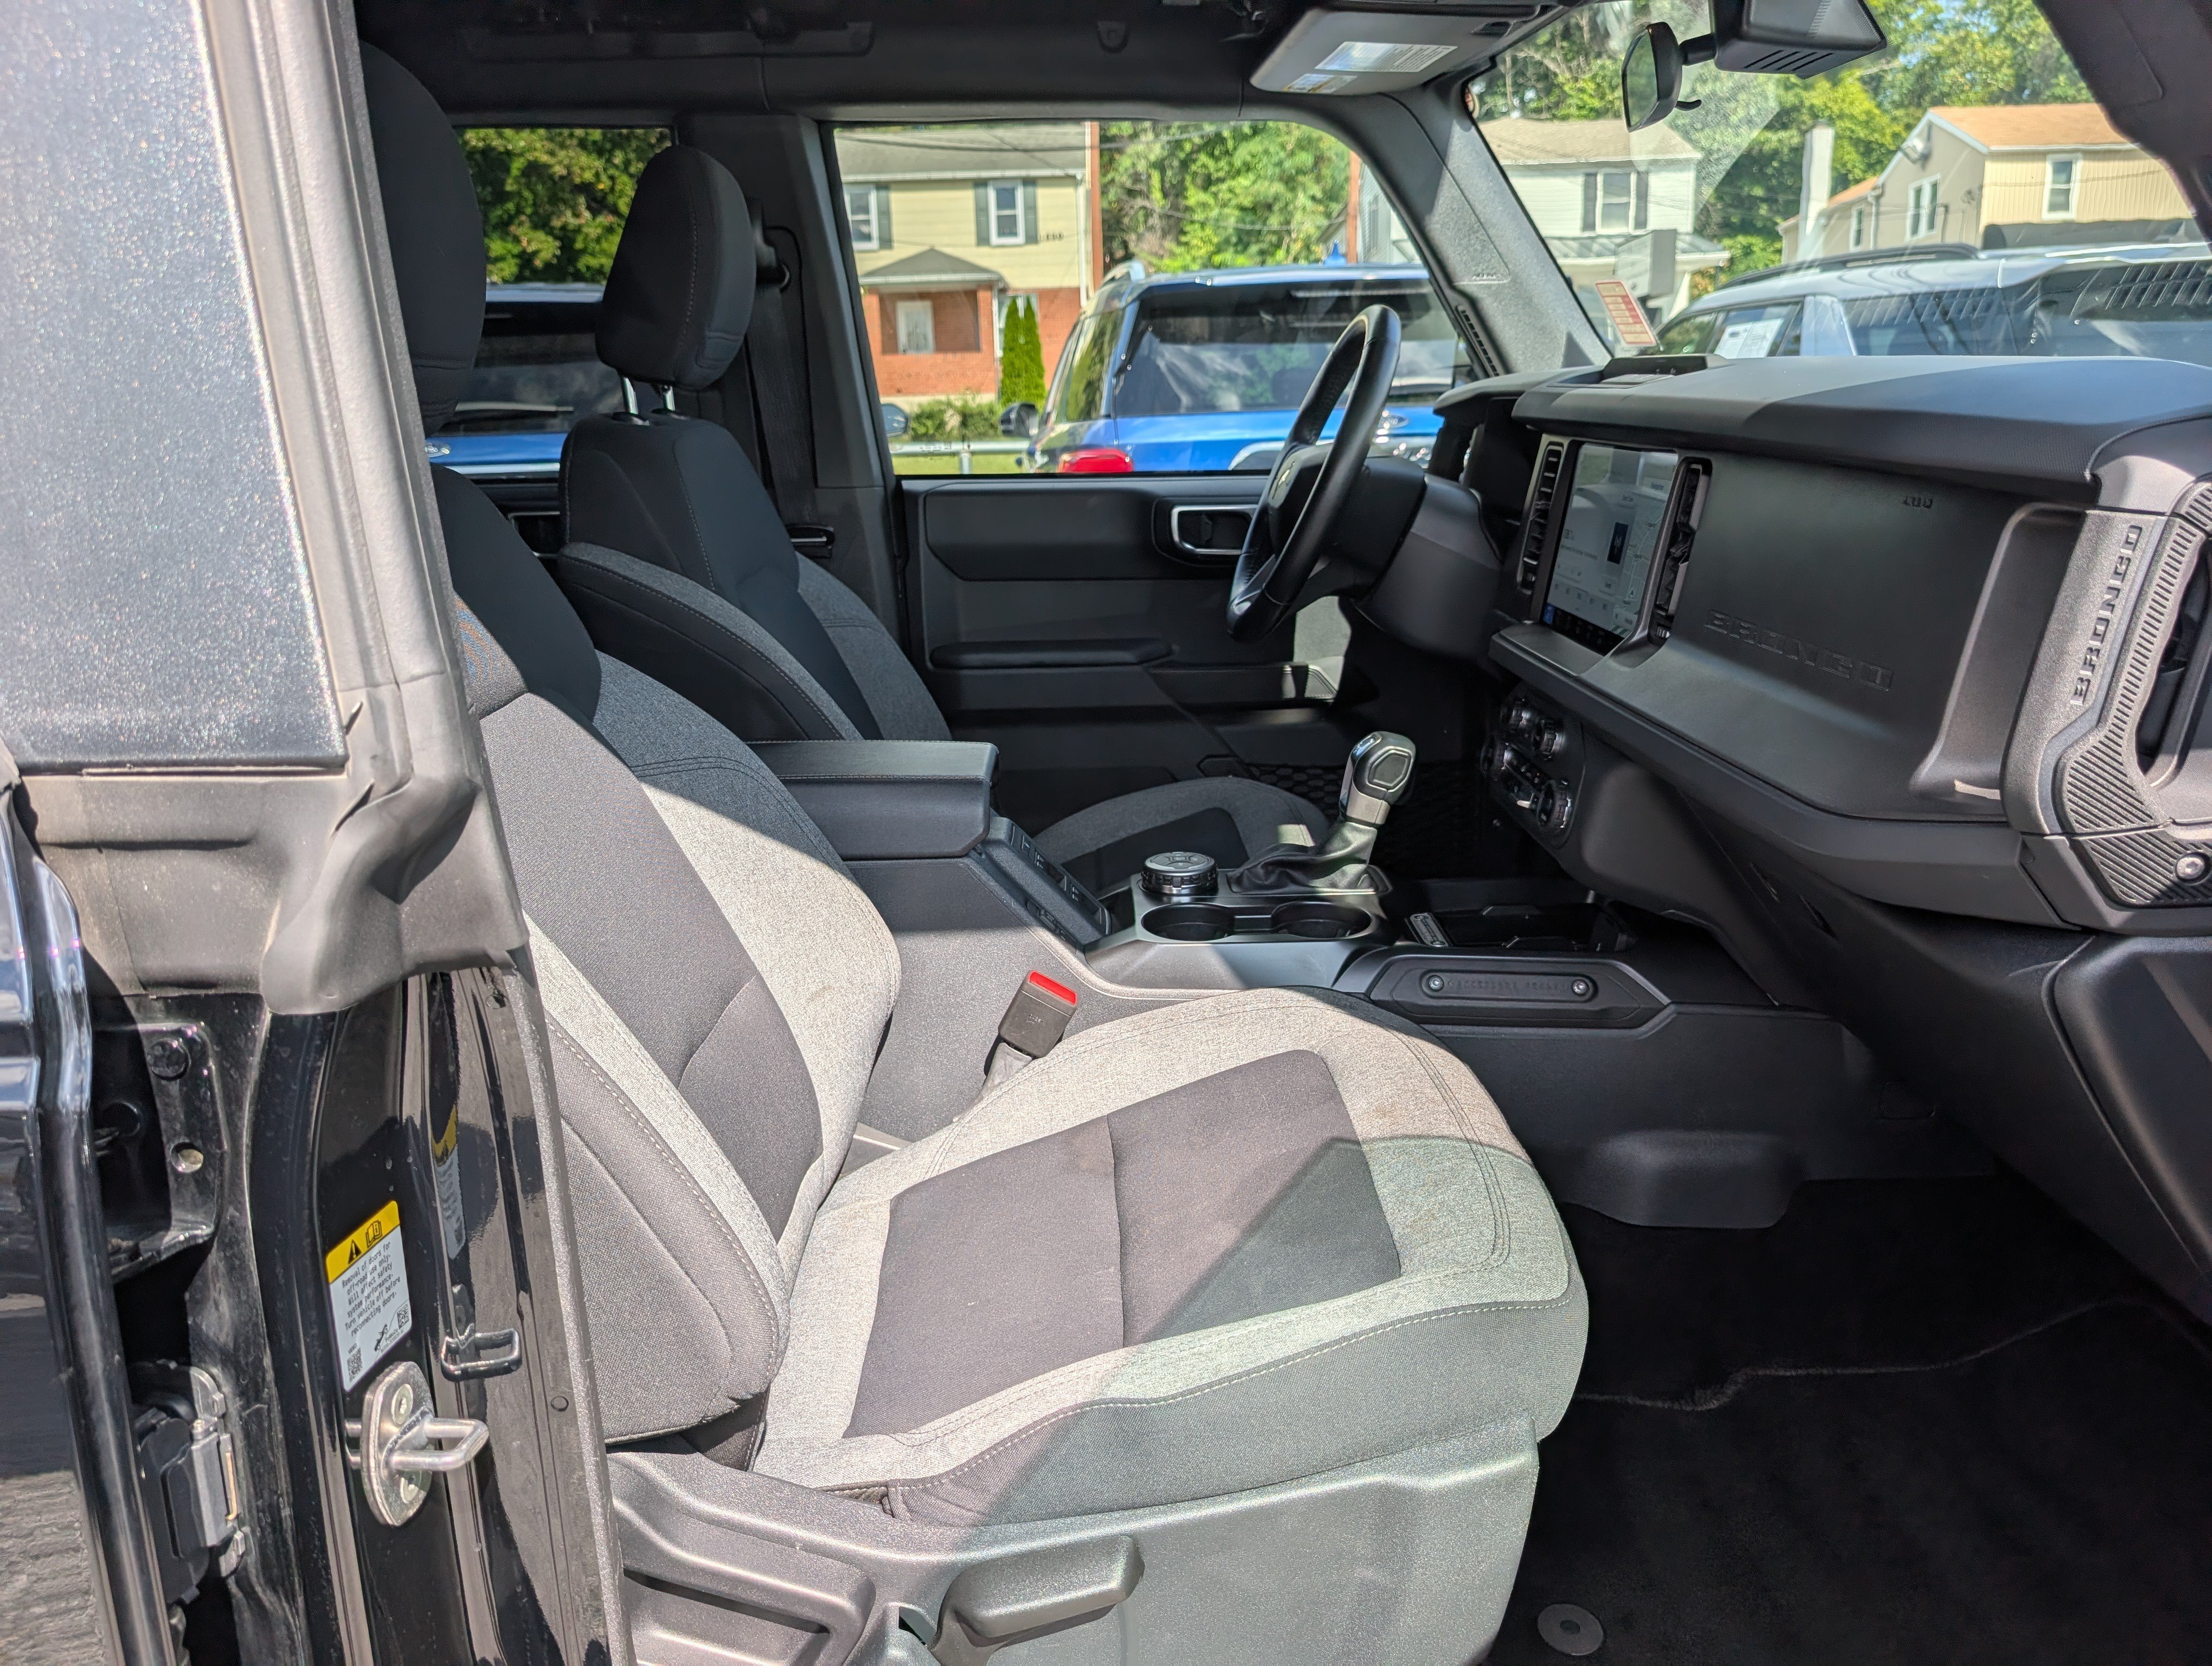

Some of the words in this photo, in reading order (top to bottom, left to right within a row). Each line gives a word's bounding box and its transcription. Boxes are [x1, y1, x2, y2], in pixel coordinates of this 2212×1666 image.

[2069, 524, 2143, 704] BRONCO
[1704, 608, 1896, 693] BRONCO
[342, 1267, 361, 1288] Removal
[362, 1261, 367, 1271] of
[369, 1250, 382, 1265] doors
[383, 1241, 391, 1252] for
[347, 1273, 368, 1295] off-road
[369, 1265, 377, 1276] use
[379, 1254, 391, 1270] only.
[348, 1290, 359, 1306] Will
[361, 1276, 376, 1295] affect
[377, 1261, 393, 1279] safety
[345, 1317, 356, 1331] Turn
[357, 1299, 375, 1319] vehicle
[385, 1276, 401, 1293] before
[347, 1299, 363, 1318] system
[364, 1274, 393, 1303] performance.
[351, 1305, 382, 1337] reconnecting
[382, 1291, 397, 1307] doors.
